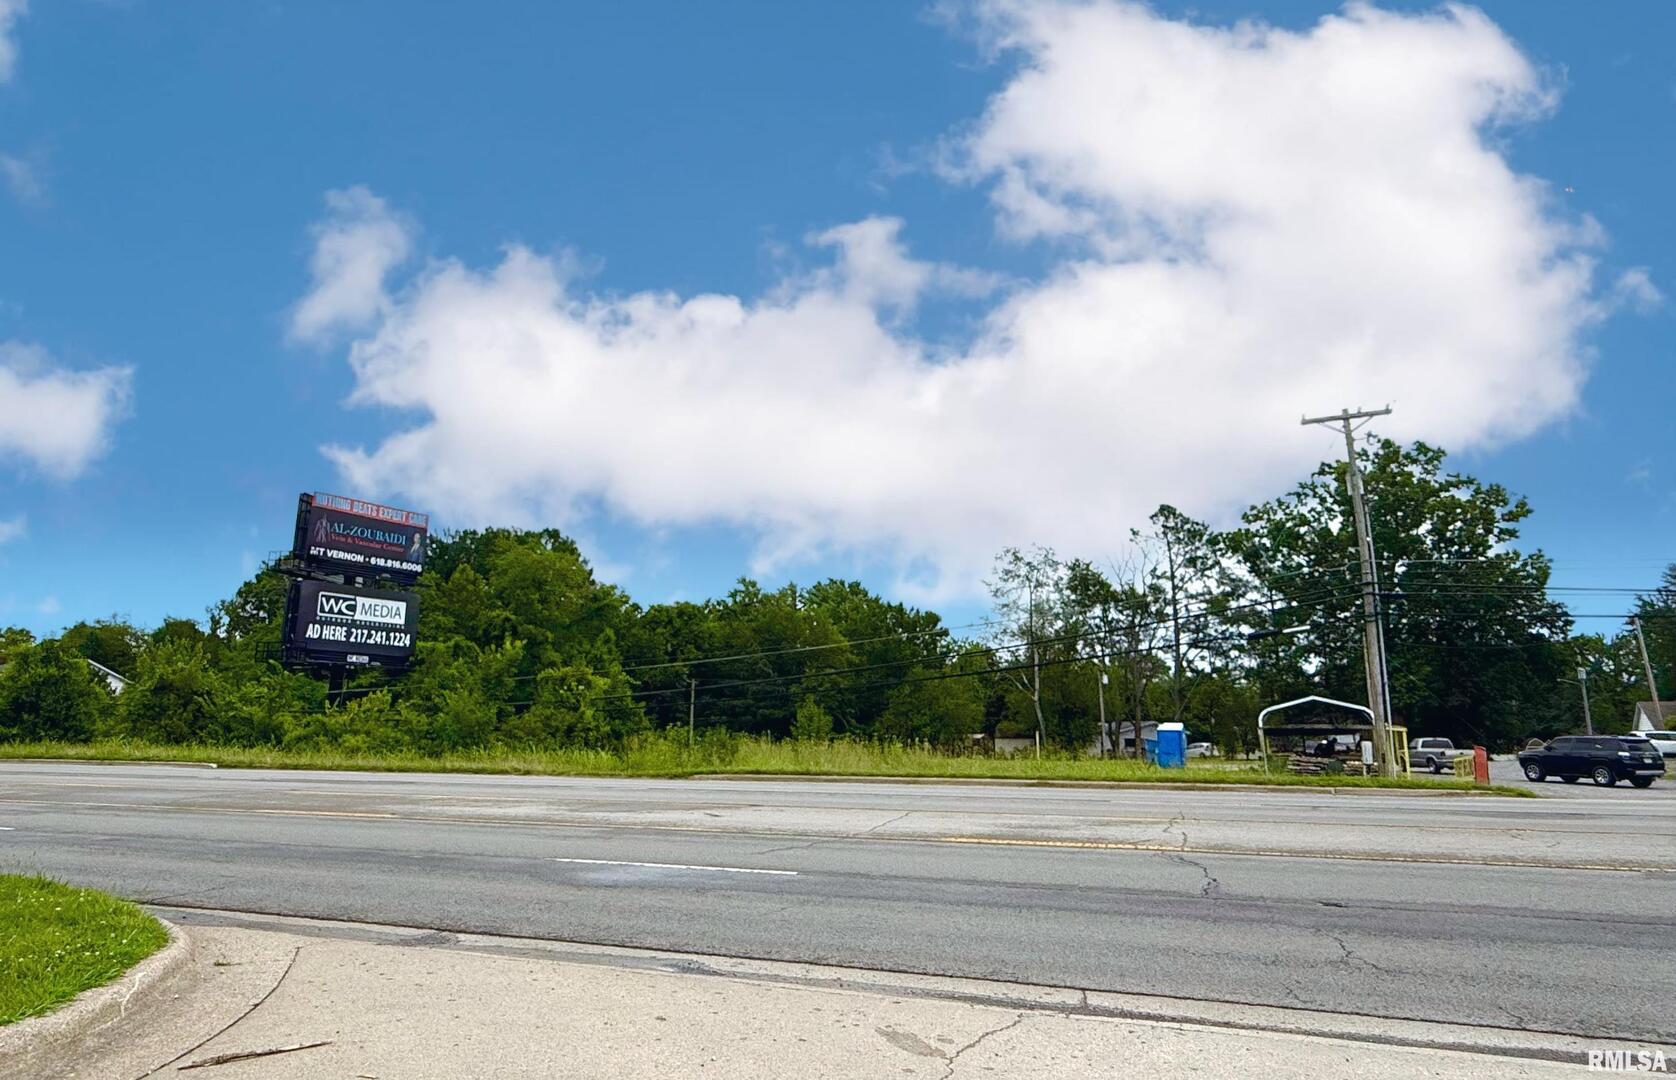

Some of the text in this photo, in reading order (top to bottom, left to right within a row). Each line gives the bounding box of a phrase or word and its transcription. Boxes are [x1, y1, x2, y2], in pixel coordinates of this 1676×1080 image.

[331, 522, 407, 545] AL-ZOUBAIDI
[310, 546, 325, 556] MT
[327, 549, 364, 563] VERNON
[321, 597, 402, 619] WC MEDIA
[305, 623, 411, 648] AD HERE 217.241.1224
